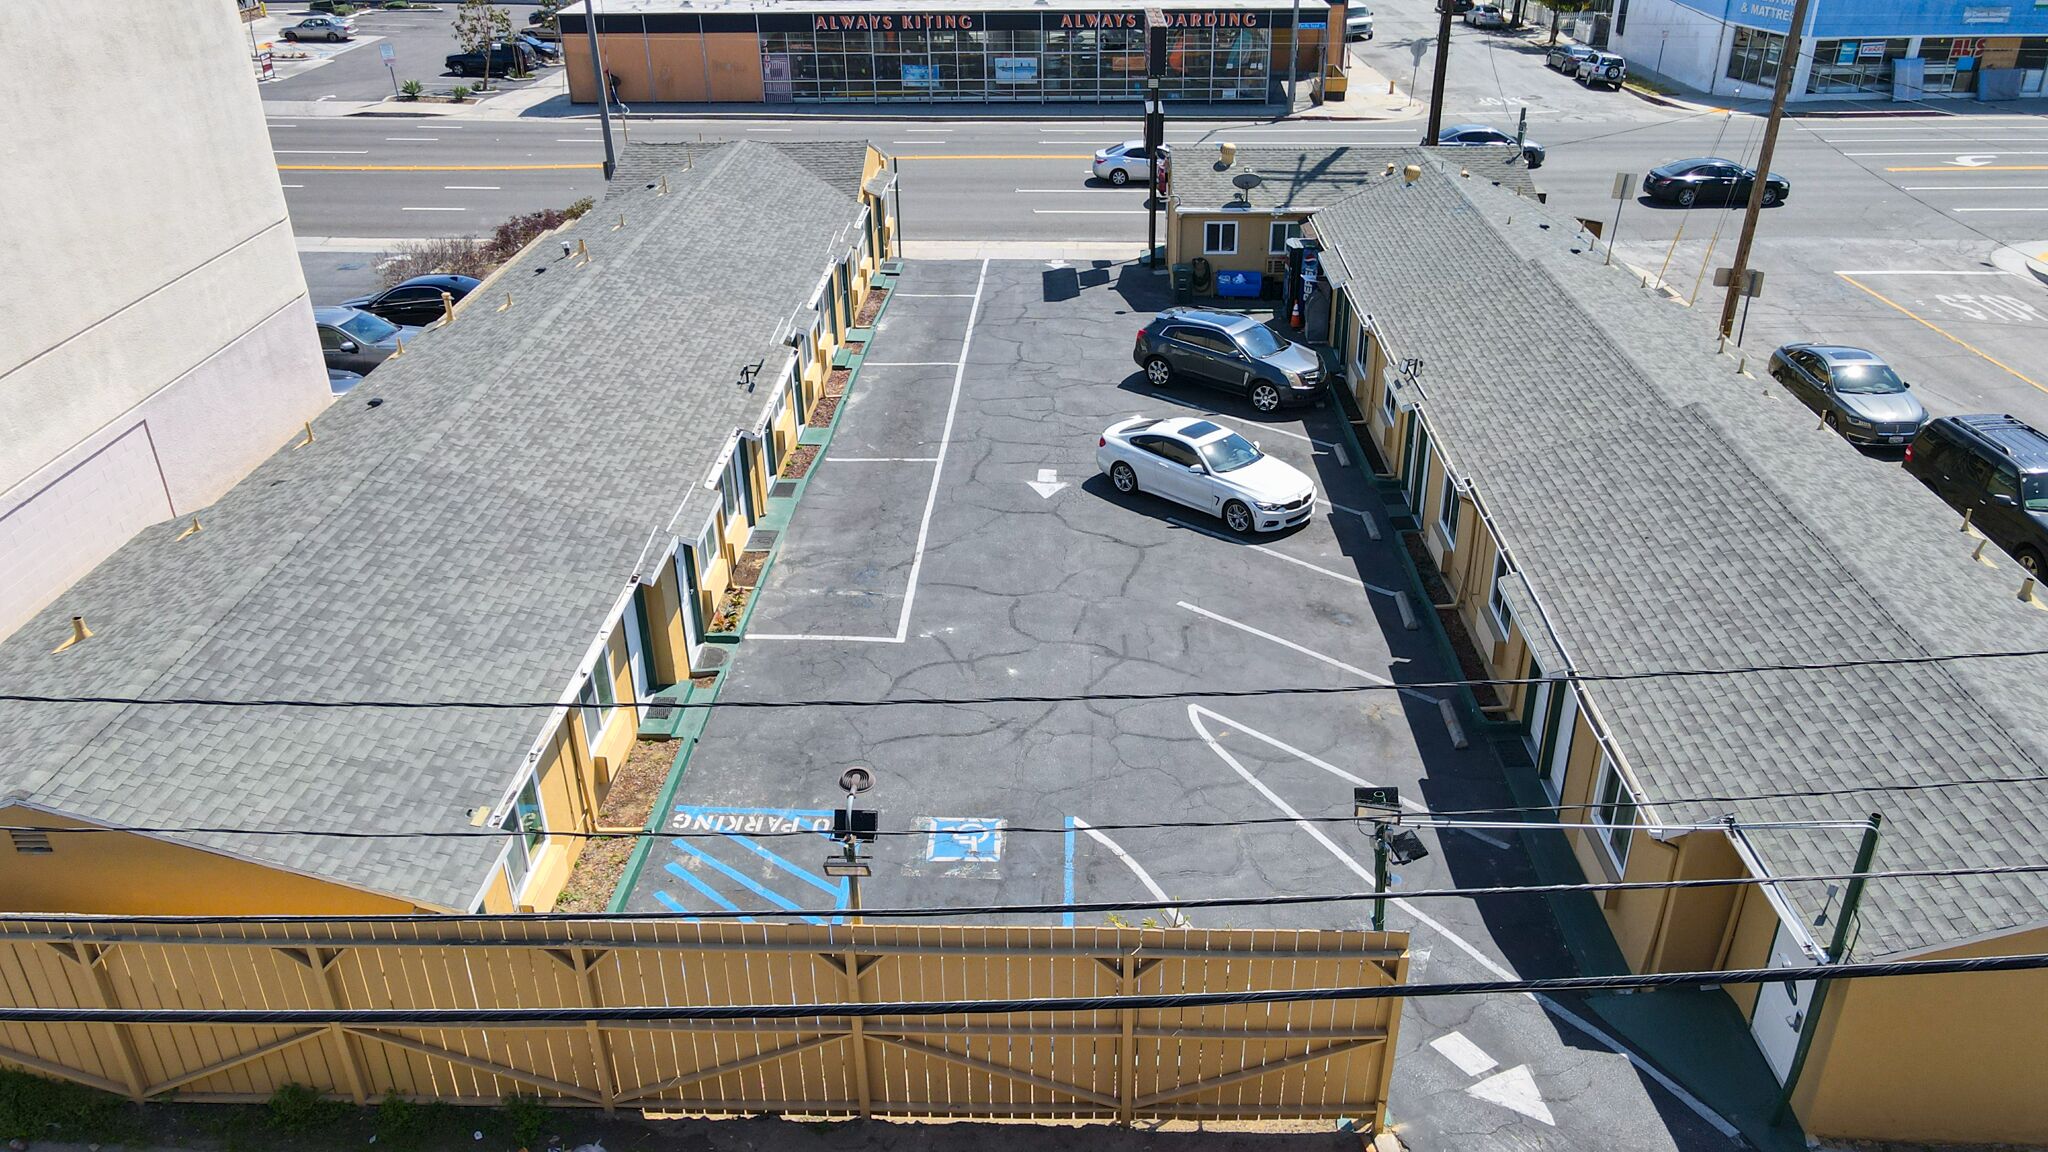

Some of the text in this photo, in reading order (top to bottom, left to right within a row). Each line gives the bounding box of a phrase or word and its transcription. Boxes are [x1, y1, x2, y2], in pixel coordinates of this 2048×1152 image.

[816, 15, 973, 30] ALWAYS KITING
[1060, 13, 1257, 28] ALWAYS OARDING
[1935, 294, 2048, 321] STOP
[672, 813, 800, 833] PARKING
